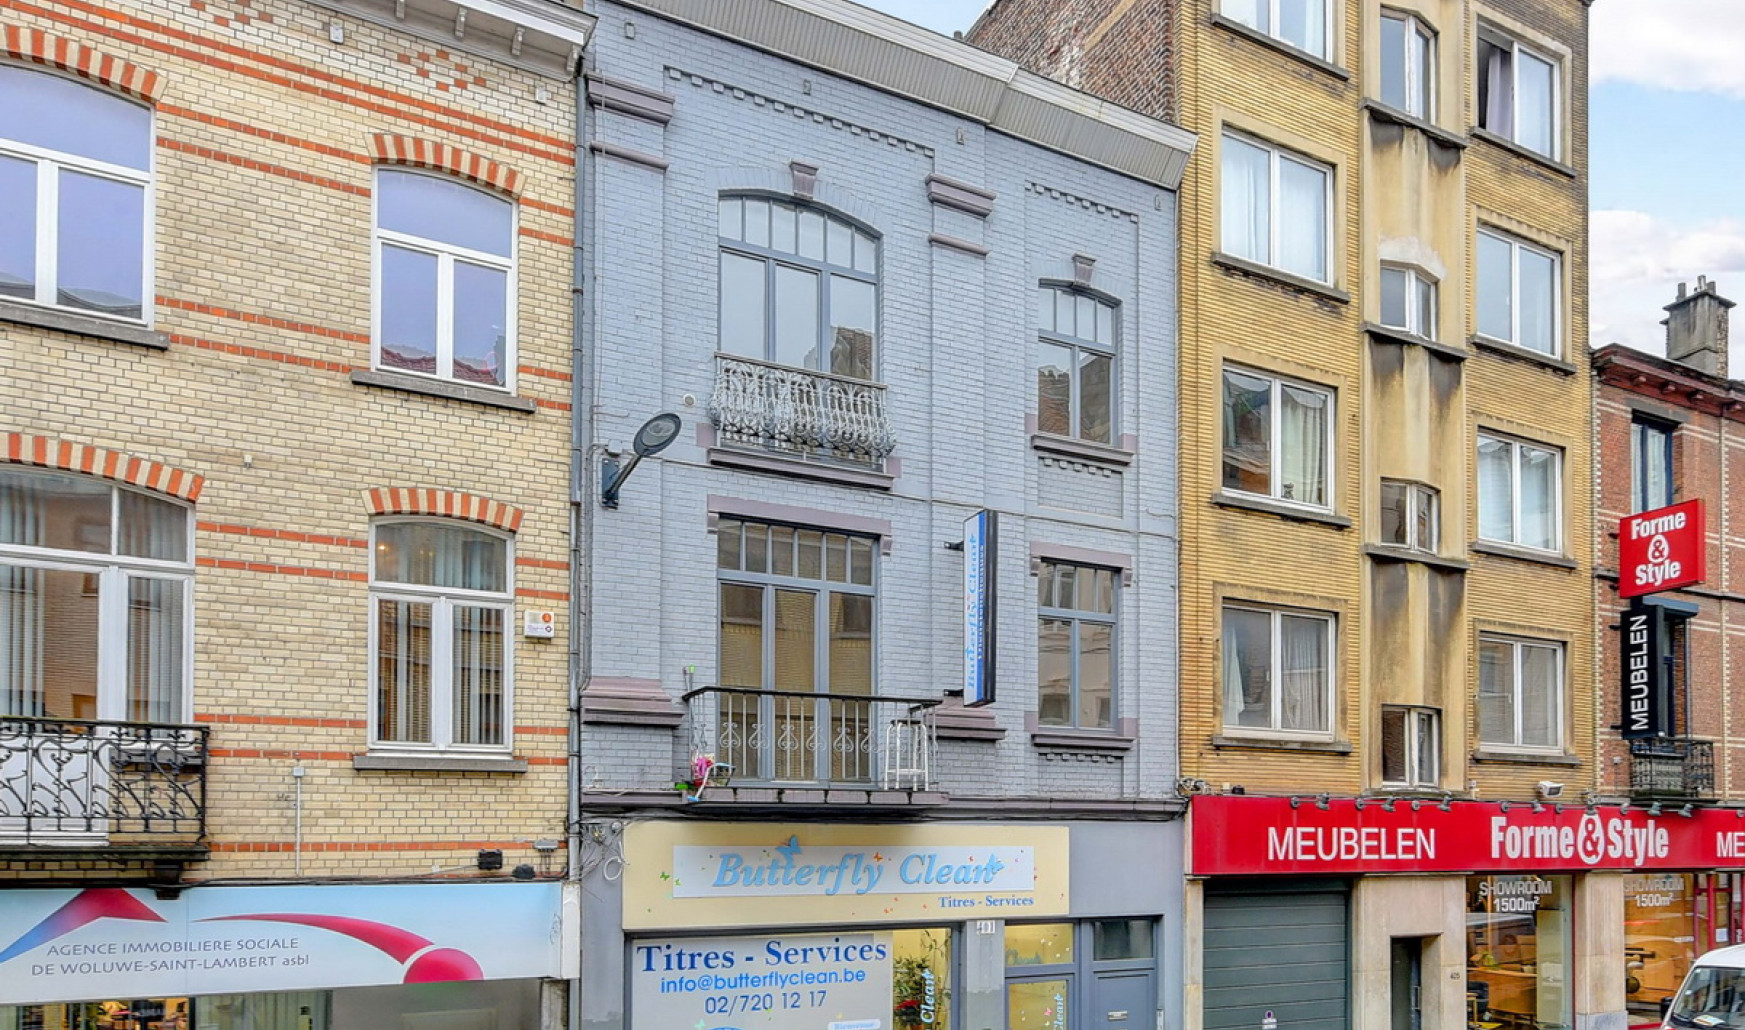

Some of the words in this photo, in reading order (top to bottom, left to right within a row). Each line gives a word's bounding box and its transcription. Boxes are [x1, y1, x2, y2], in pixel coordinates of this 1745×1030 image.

[1630, 512, 1687, 540] Forme
[1649, 536, 1668, 562] &
[1635, 560, 1681, 587] Style
[1630, 614, 1649, 731] MEUBELEN
[1267, 826, 1436, 861] MEUBELEN
[1491, 816, 1575, 859] Forme
[1580, 815, 1603, 861] &
[1607, 818, 1669, 867] Style
[712, 852, 884, 896] Butterfly
[899, 852, 997, 885] Clean
[1623, 878, 1685, 892] SHOWROOM
[938, 896, 975, 908] Titres
[985, 895, 1034, 907] Services
[1479, 880, 1553, 896] SHOWROOM
[47, 943, 117, 956] AGENCE
[122, 940, 232, 954] IMMOBILIERE
[236, 938, 299, 951] SOCIALE
[637, 944, 735, 972] Titres
[765, 937, 888, 966] Services
[32, 964, 55, 976] DE
[60, 956, 277, 975] WOLUWE-SAINT-LAMBERT
[281, 954, 309, 966] asbl
[660, 967, 866, 994] info@butterflyclean.be
[704, 993, 773, 1017] 02/720
[781, 991, 801, 1009] 12
[809, 990, 827, 1007] 17
